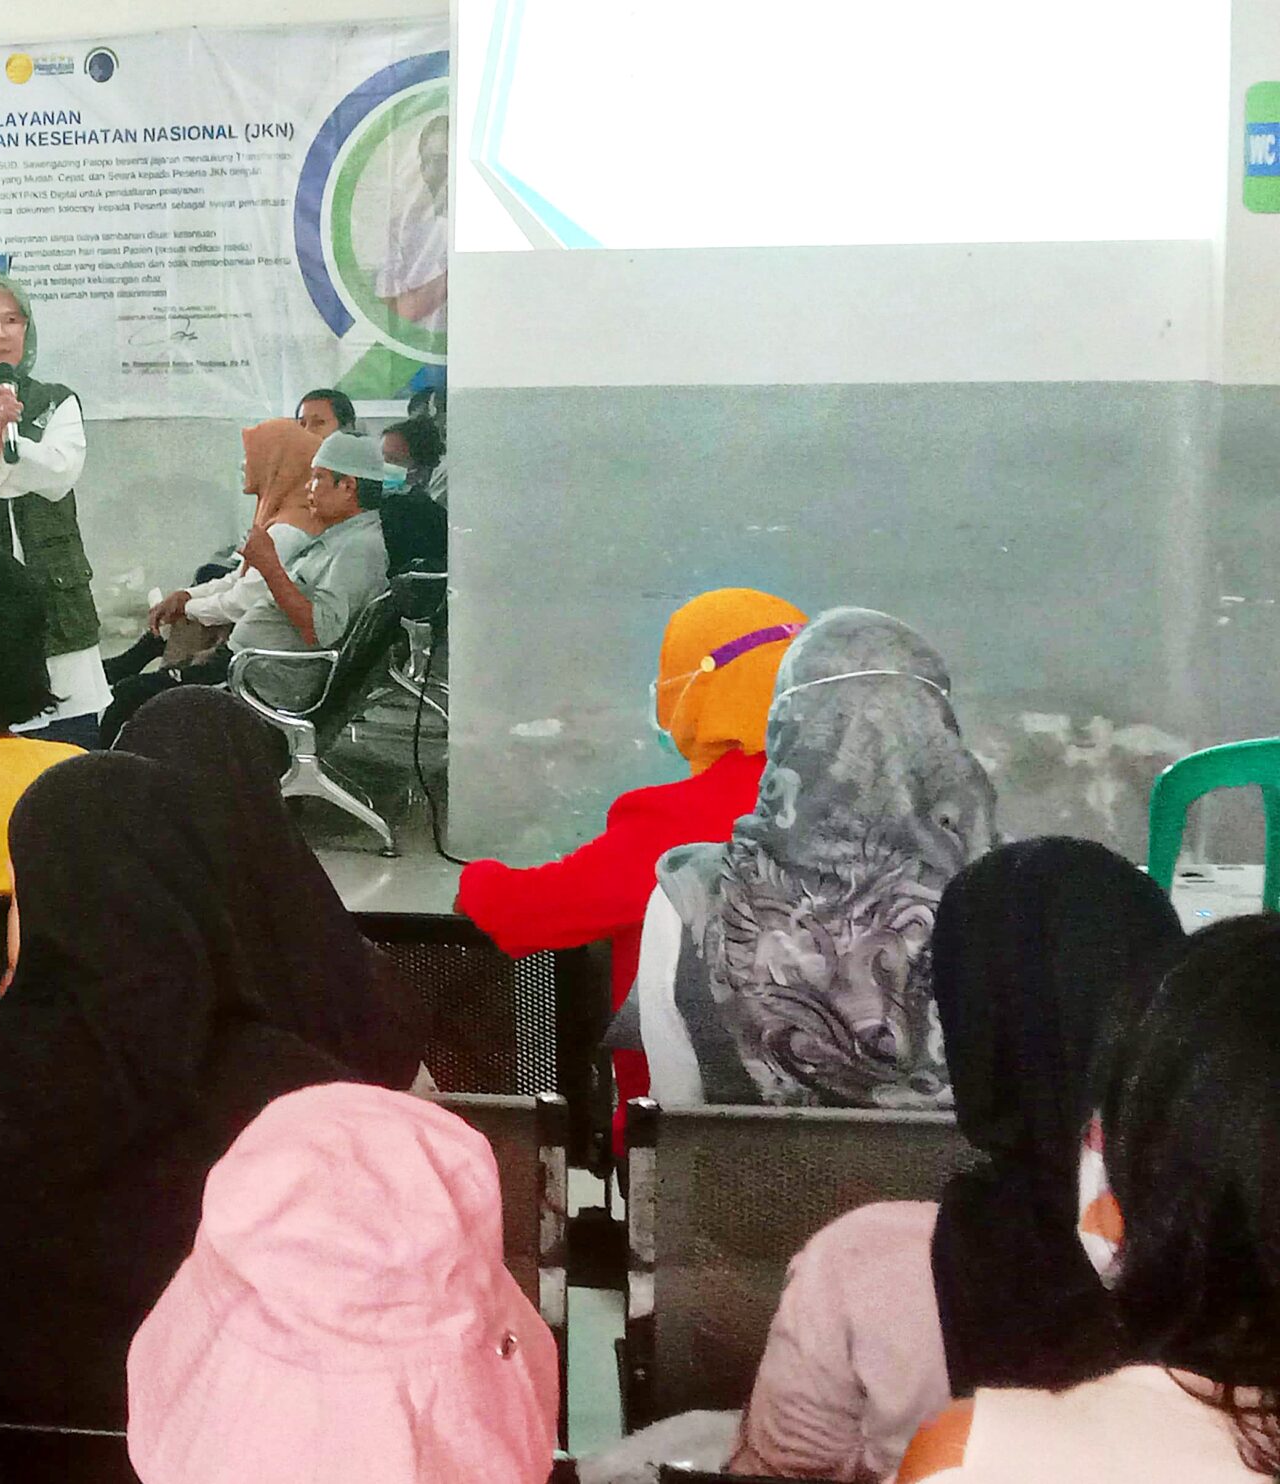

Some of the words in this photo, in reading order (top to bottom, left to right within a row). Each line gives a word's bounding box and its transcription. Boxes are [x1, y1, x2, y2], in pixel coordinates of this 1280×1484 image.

[25, 129, 137, 147] KESEHATAN
[143, 125, 238, 143] NASIONAL
[244, 122, 295, 143] (JKN)
[1248, 134, 1276, 165] WC
[1, 175, 21, 186] yang
[74, 261, 96, 272] yang
